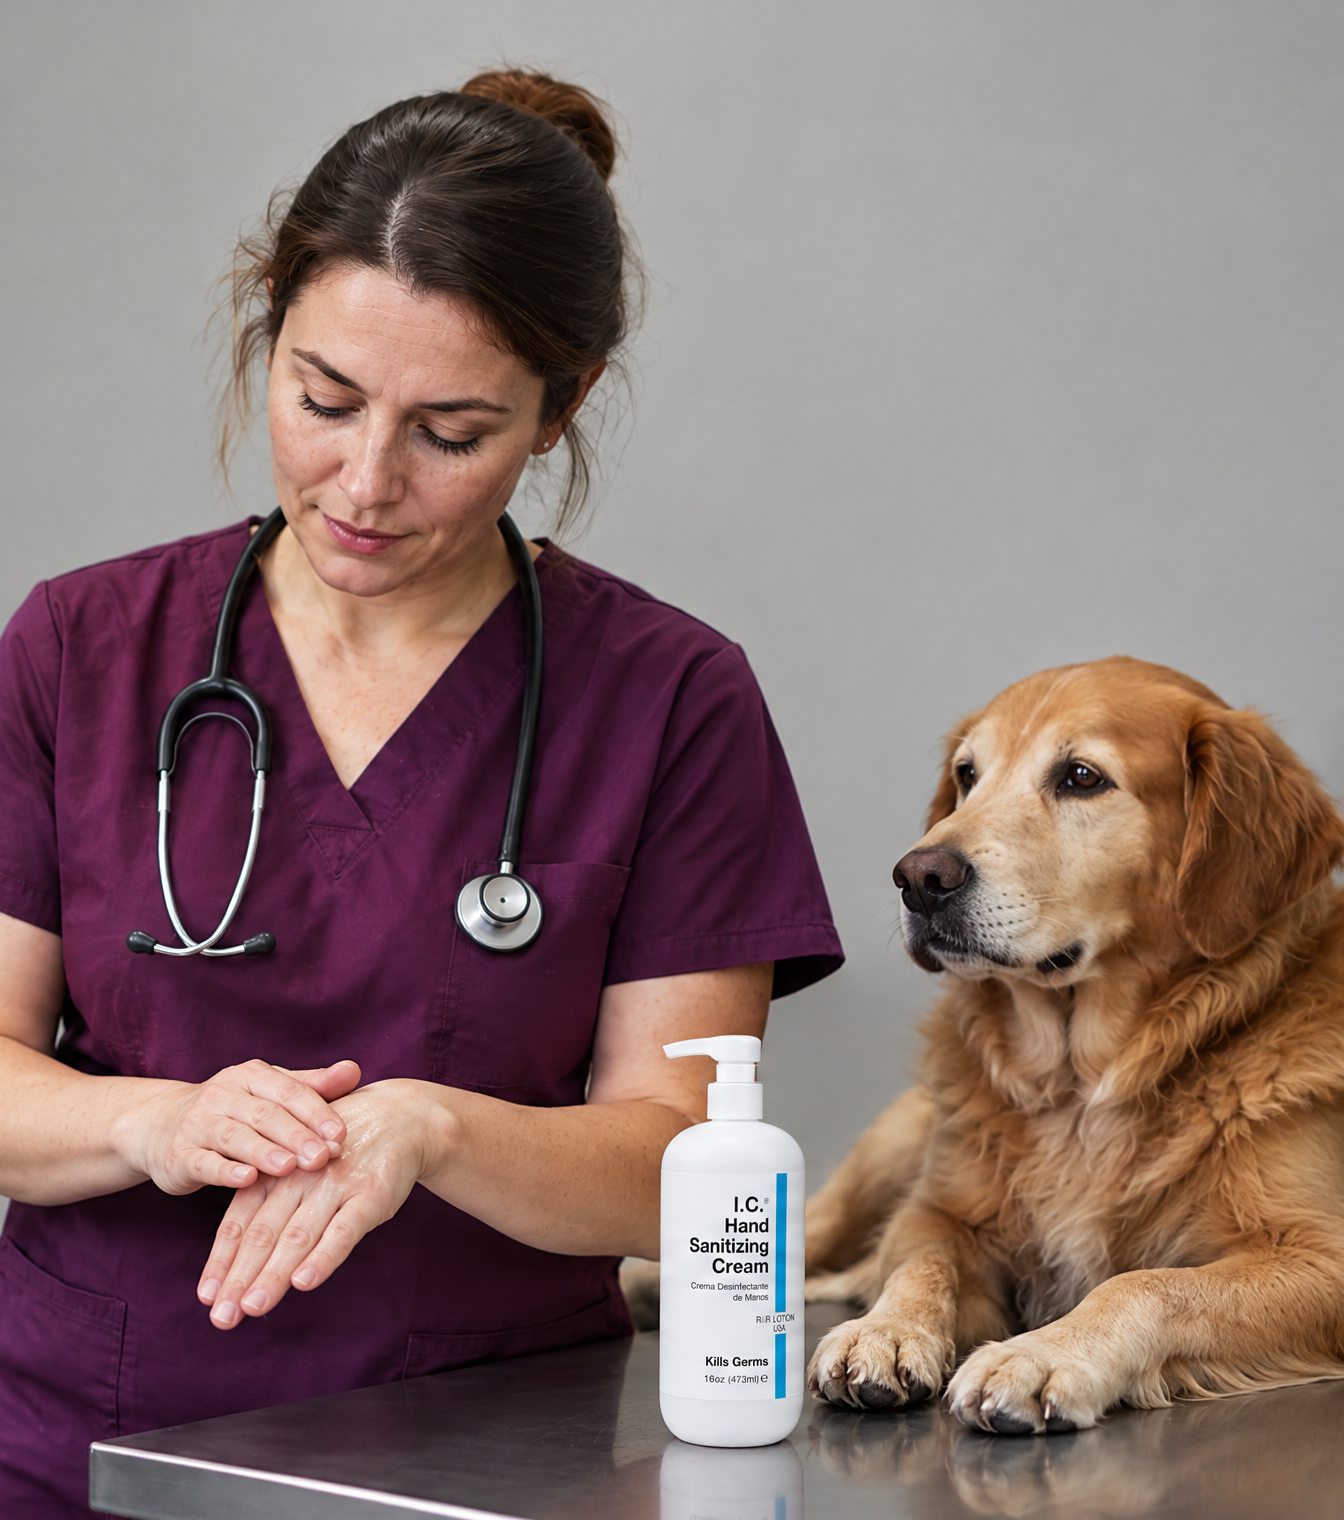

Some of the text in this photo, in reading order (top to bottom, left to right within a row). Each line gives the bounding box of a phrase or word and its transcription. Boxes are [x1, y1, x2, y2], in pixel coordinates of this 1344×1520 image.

[725, 1218, 769, 1233] Hand
[689, 1237, 769, 1257] Sanitizing
[712, 1258, 769, 1274] Cream
[690, 1281, 769, 1291] Crema Desinfectante
[733, 1293, 769, 1302] de Manos
[705, 1356, 769, 1367] Kills Germs
[704, 1374, 725, 1383] 16oz
[728, 1374, 759, 1385] (473ml)
